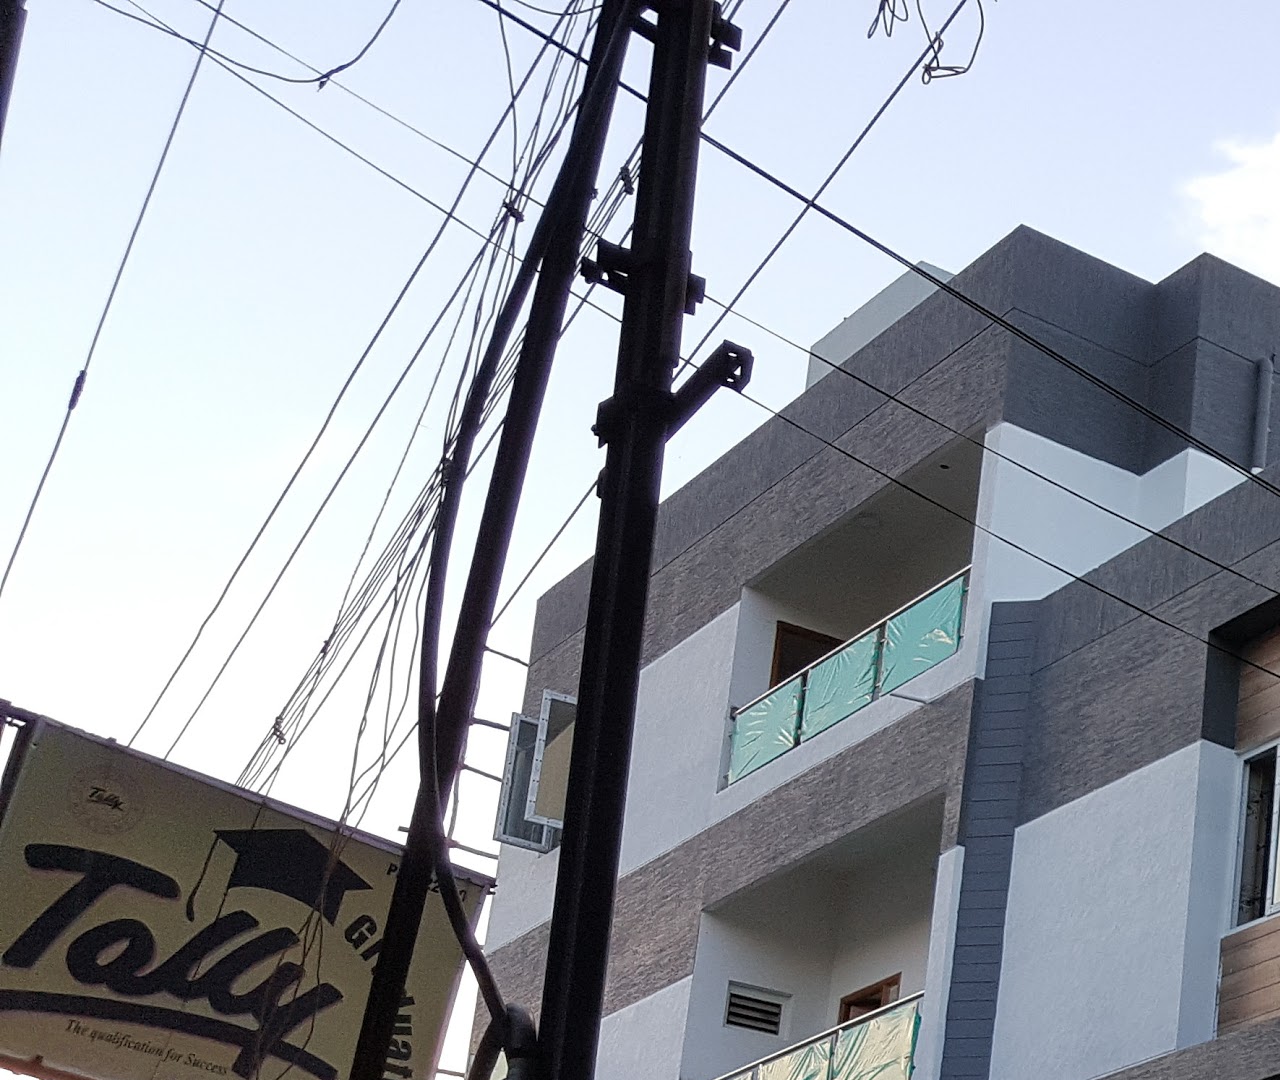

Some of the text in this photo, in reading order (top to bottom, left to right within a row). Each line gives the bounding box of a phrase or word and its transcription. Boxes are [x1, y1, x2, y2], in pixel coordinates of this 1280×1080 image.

[1, 842, 344, 1080] Tally
[65, 1018, 228, 1075] The qualification for Success
